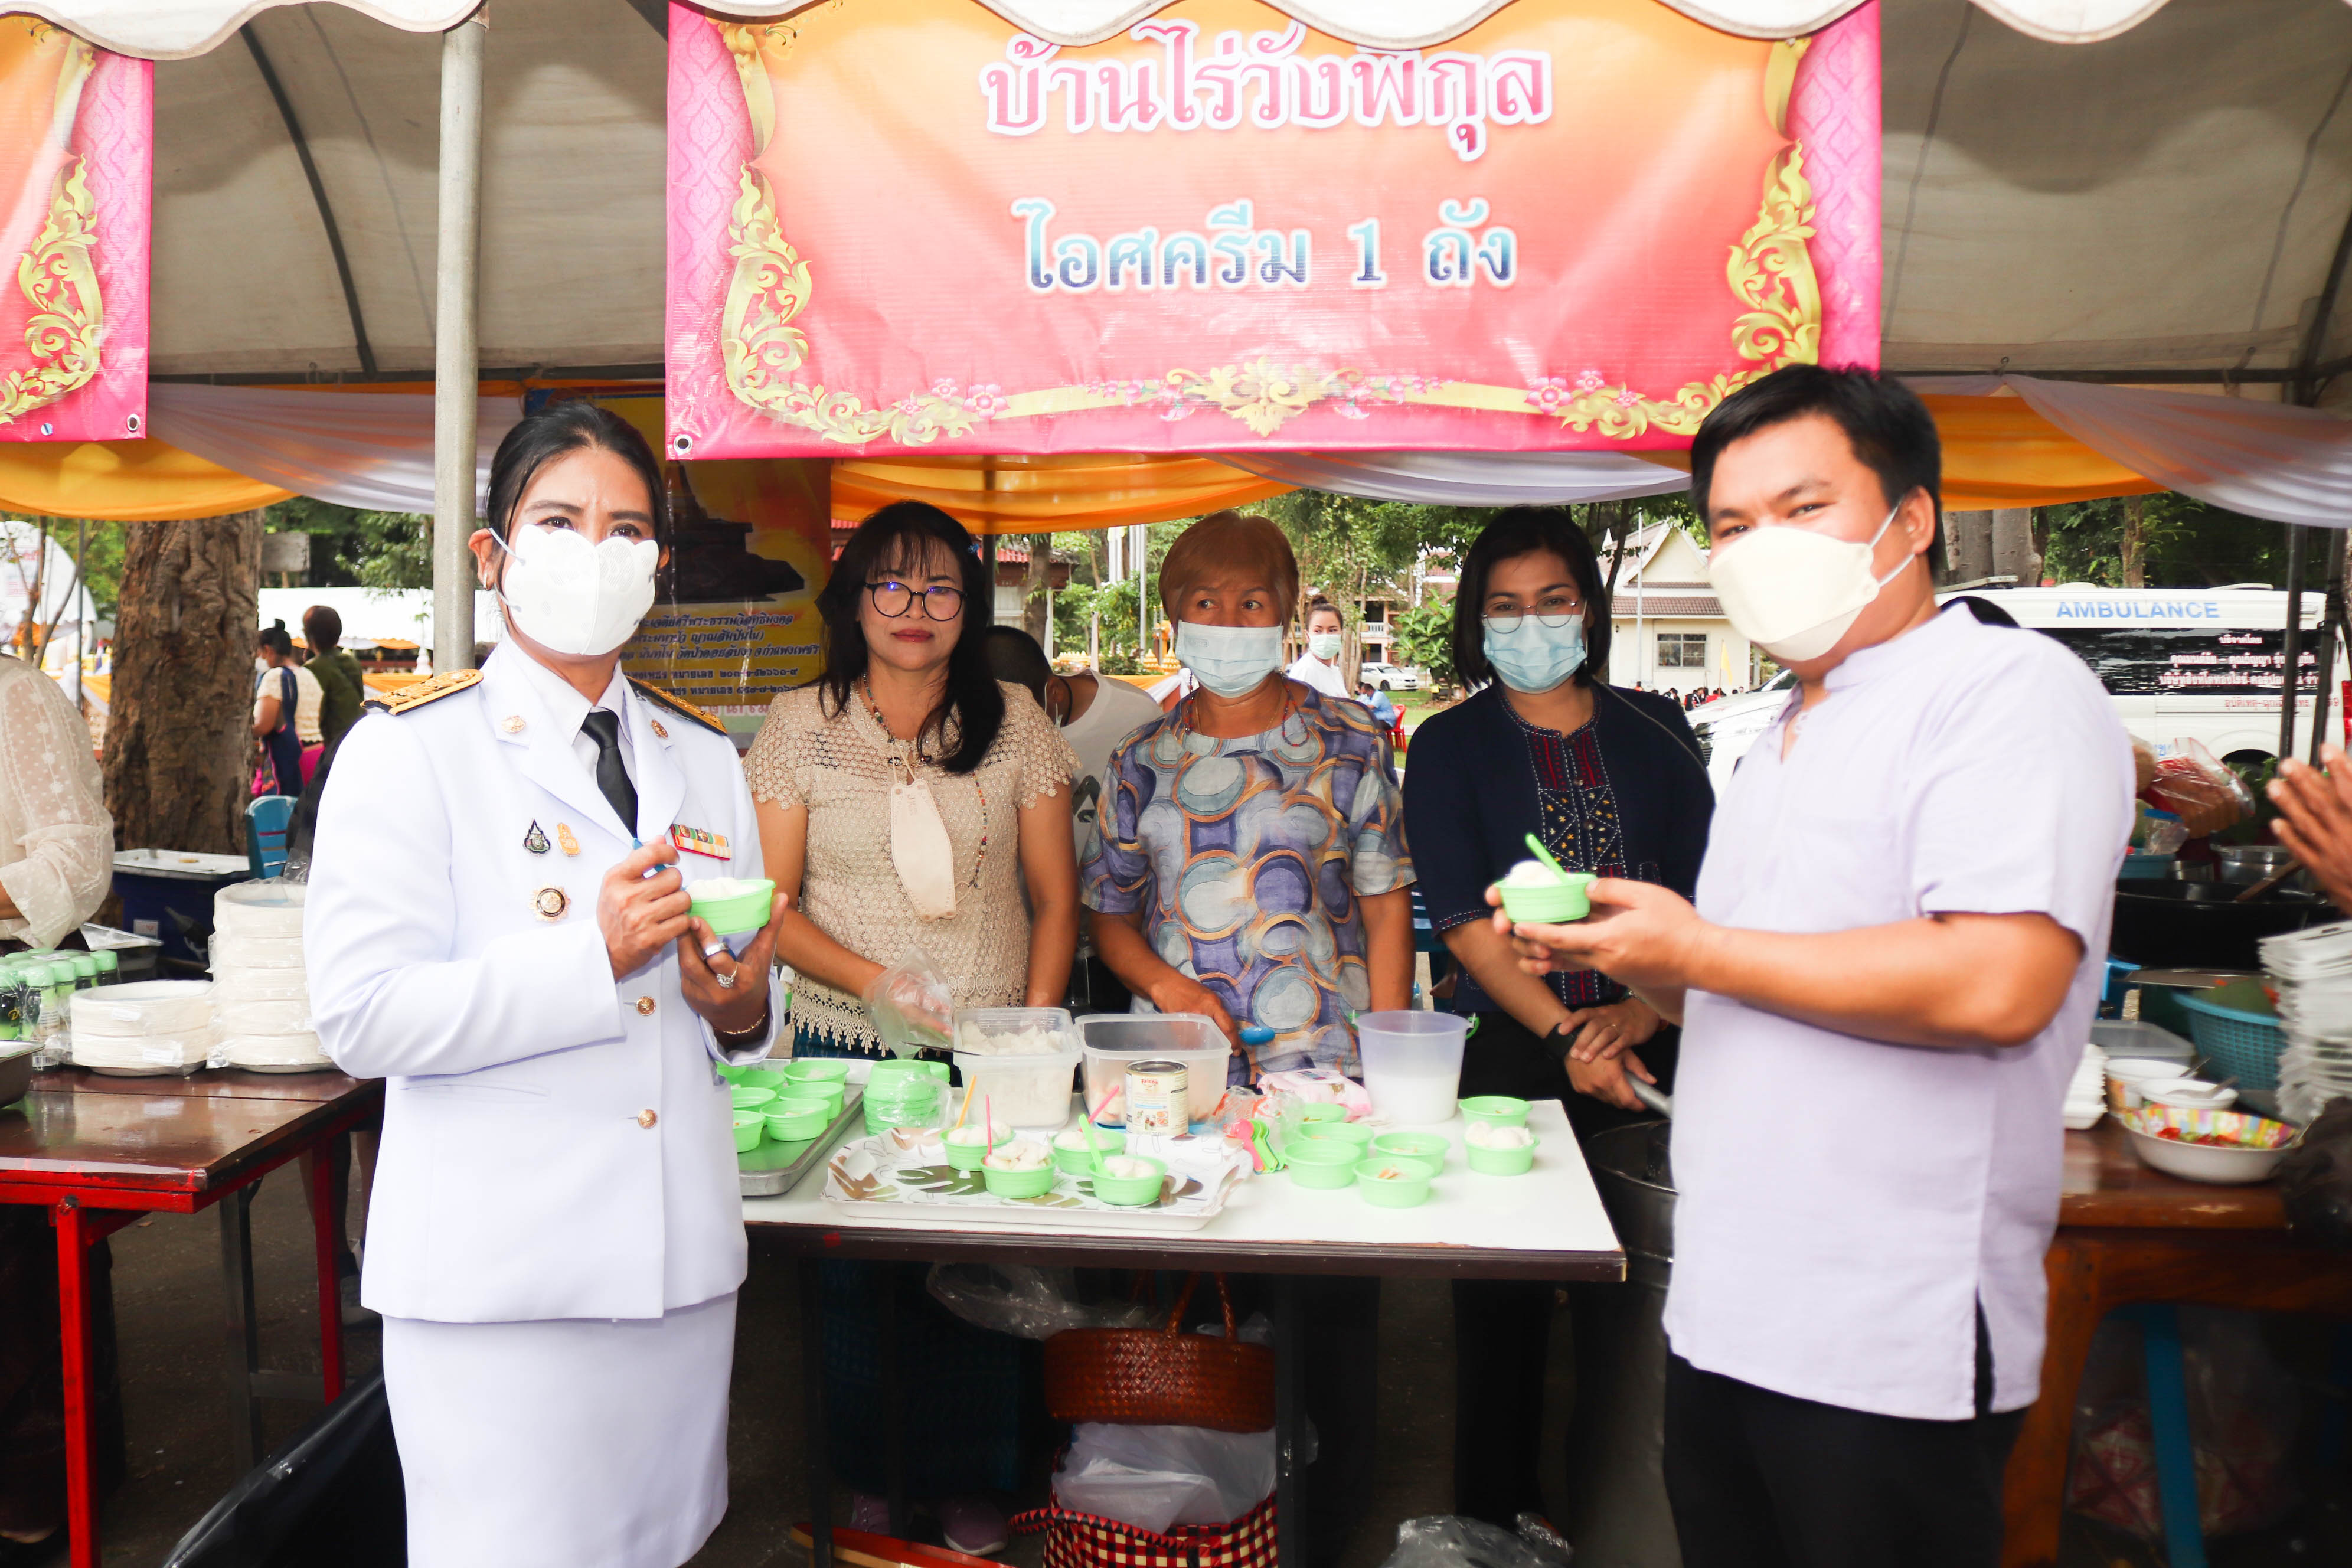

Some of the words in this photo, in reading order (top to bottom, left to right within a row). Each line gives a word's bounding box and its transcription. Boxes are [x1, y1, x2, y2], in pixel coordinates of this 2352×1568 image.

[982, 21, 1549, 158] บ้านไร่วังพกุล
[1013, 198, 1311, 292] ไอศครีม
[1349, 217, 1386, 287] 1
[1425, 198, 1517, 288] ถัง
[2056, 601, 2220, 619] AMBULANCE
